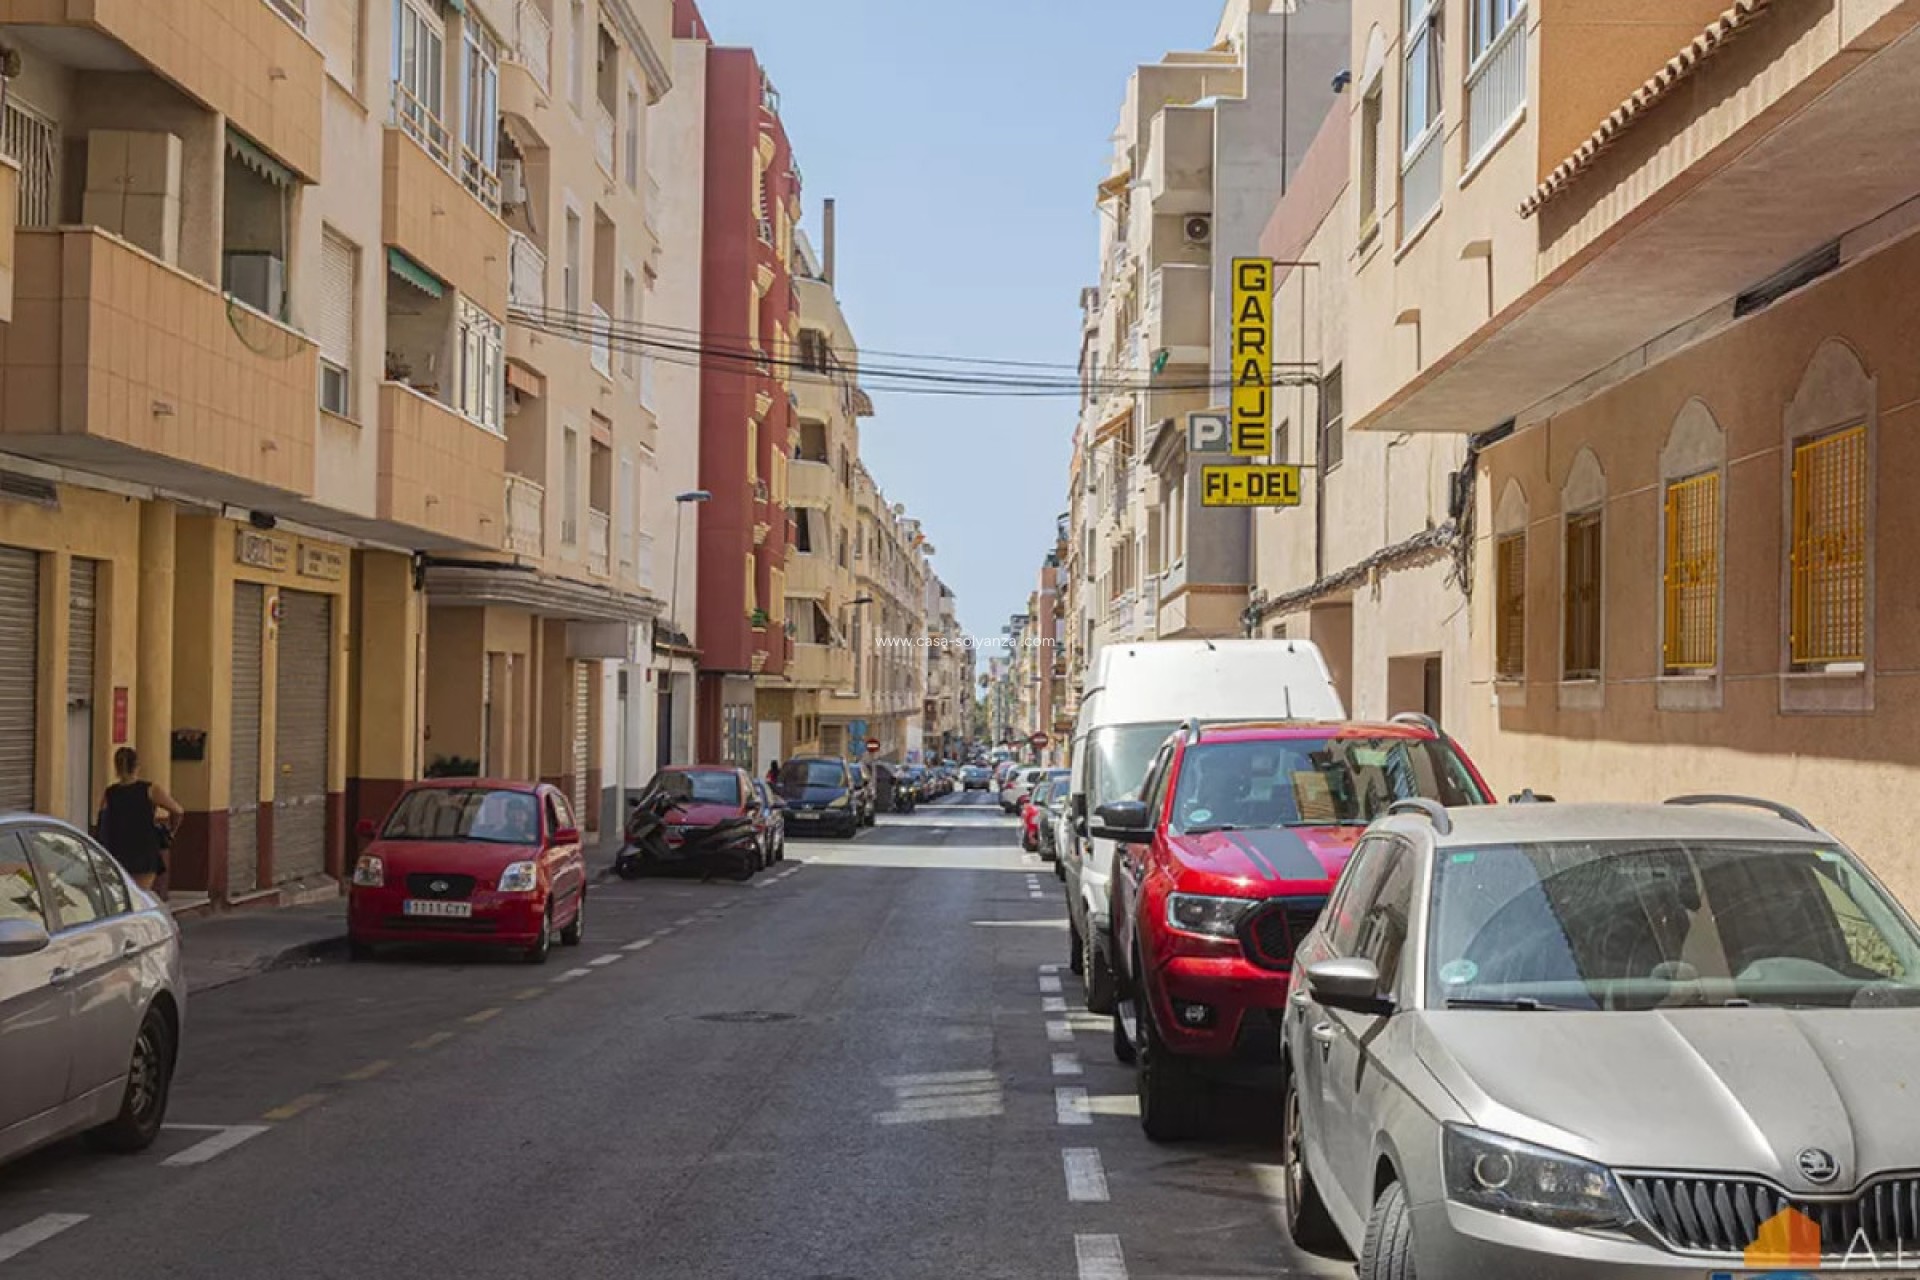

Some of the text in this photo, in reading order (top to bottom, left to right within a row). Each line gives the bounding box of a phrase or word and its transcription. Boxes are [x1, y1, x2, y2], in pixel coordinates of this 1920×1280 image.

[1237, 263, 1266, 450] GARAJE
[1194, 417, 1223, 449] P
[1207, 472, 1297, 497] FI-DEL
